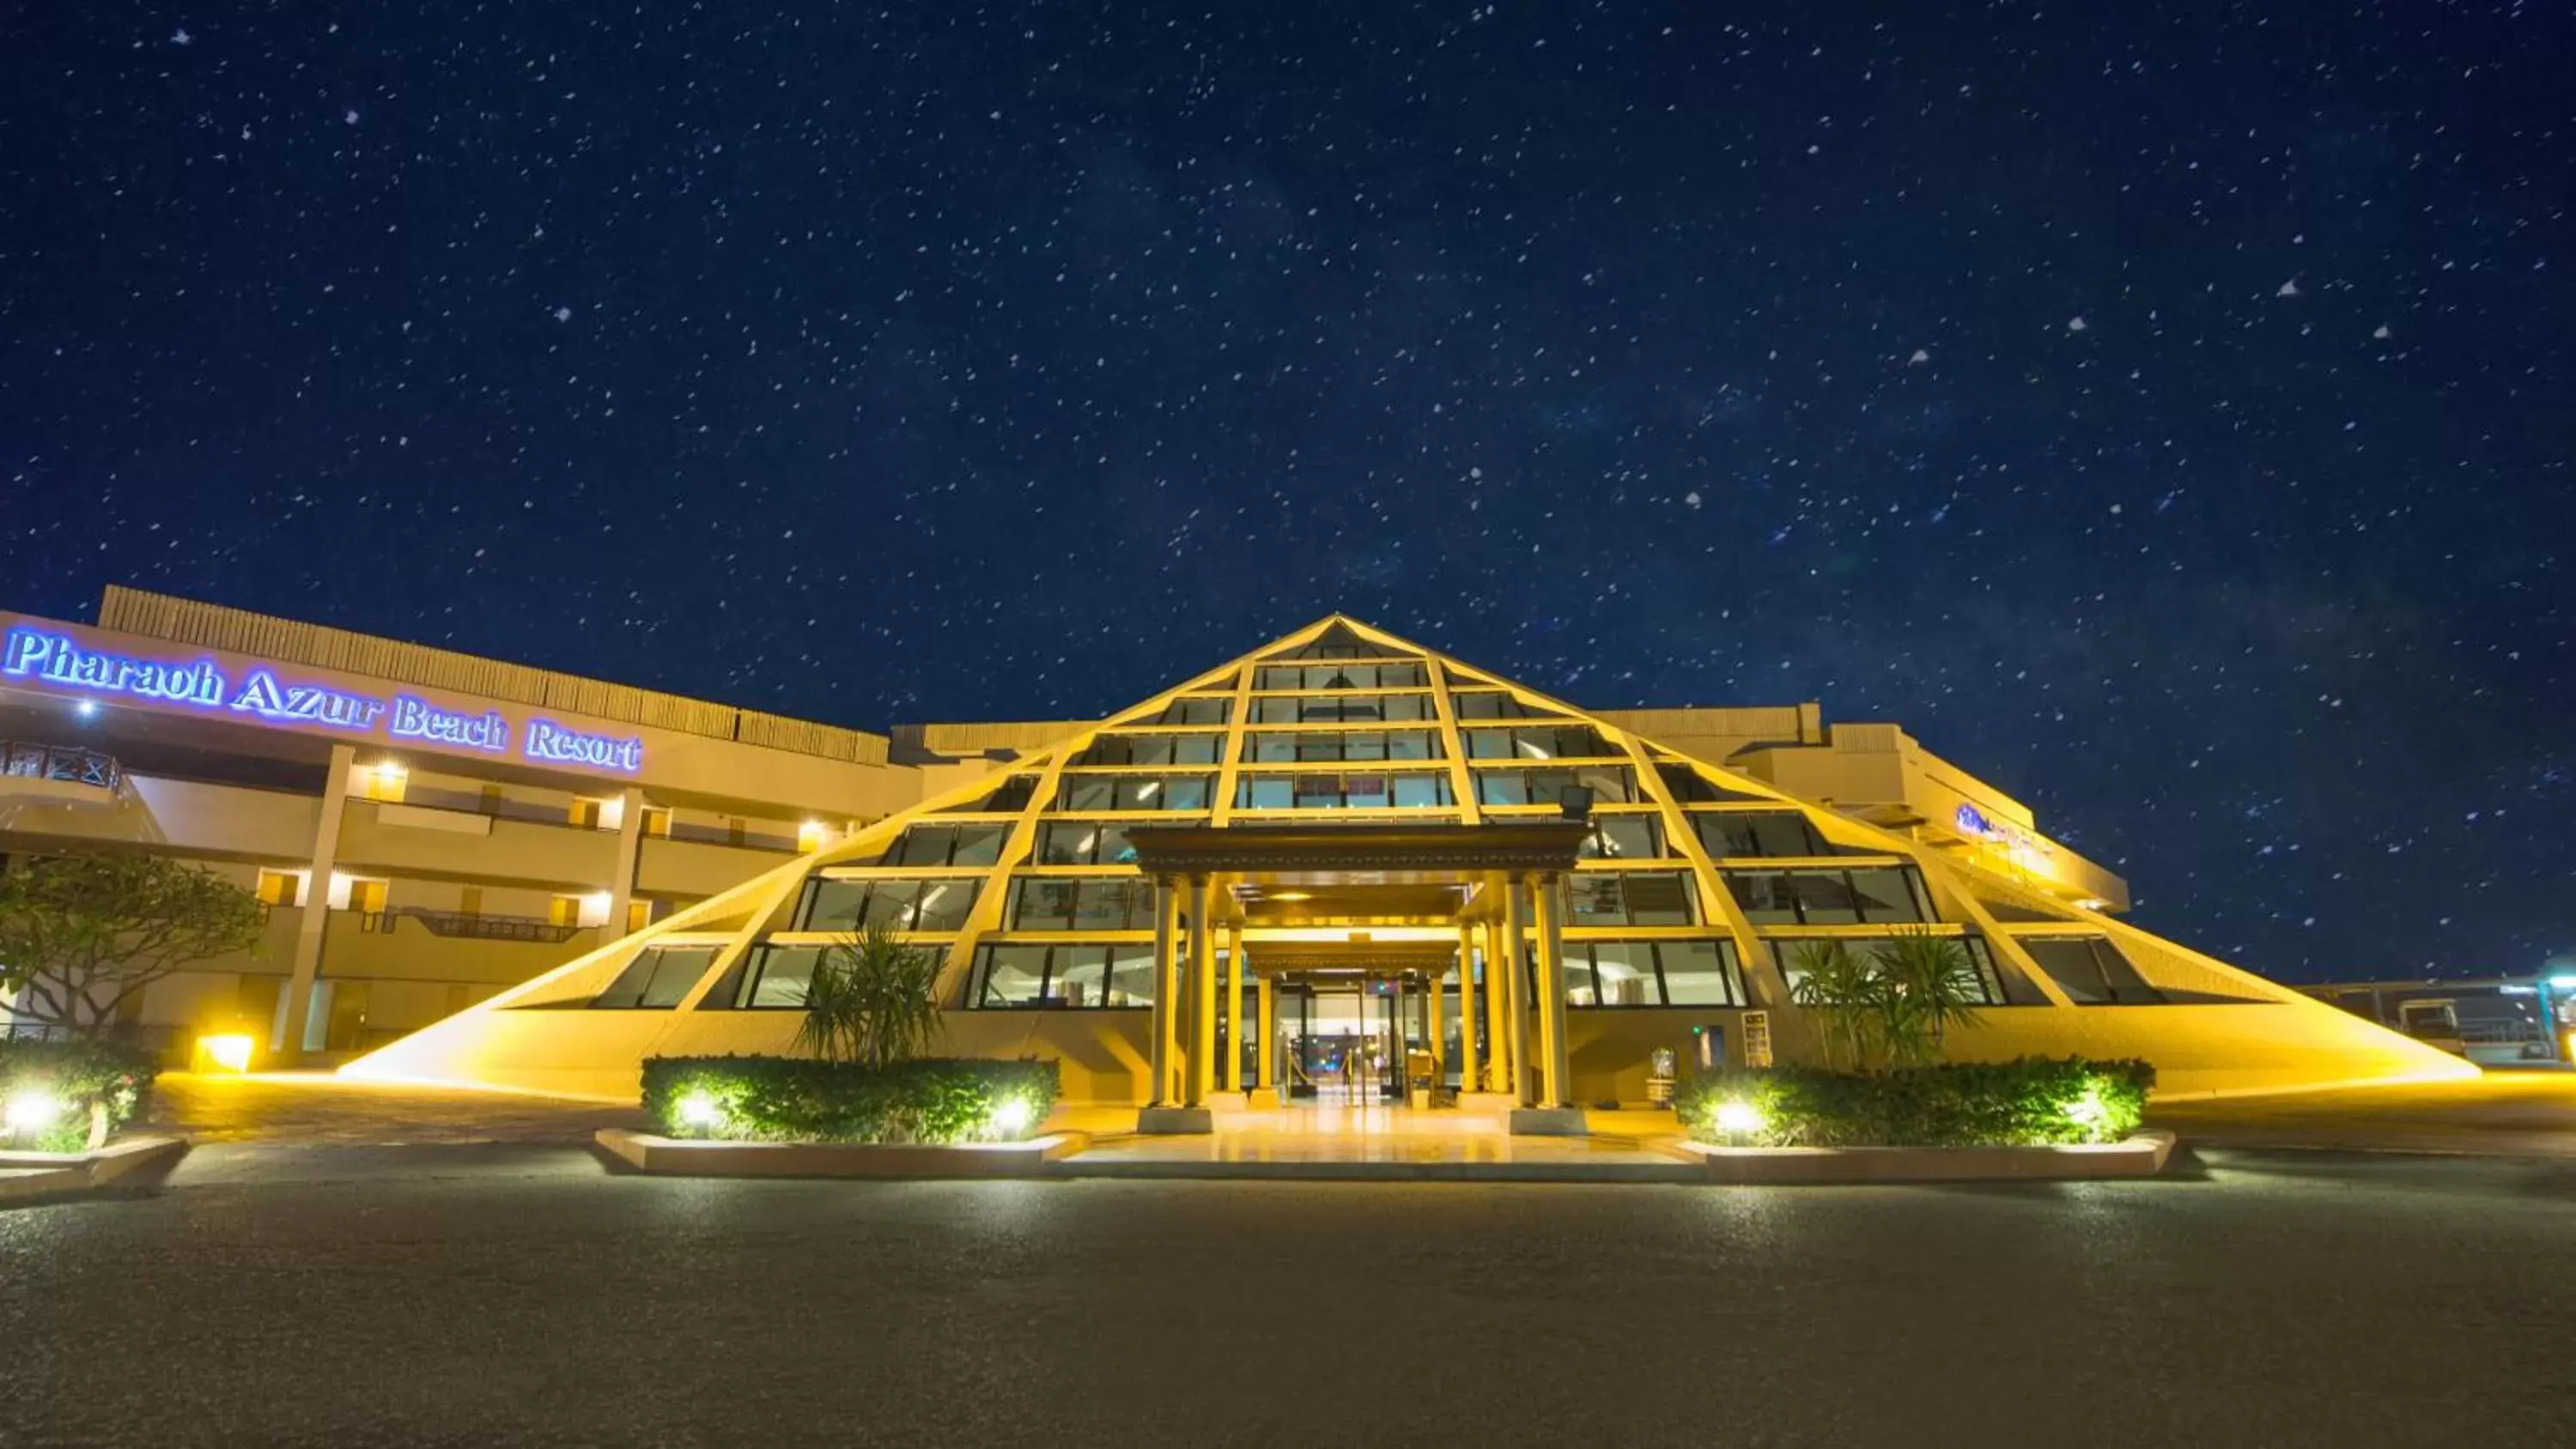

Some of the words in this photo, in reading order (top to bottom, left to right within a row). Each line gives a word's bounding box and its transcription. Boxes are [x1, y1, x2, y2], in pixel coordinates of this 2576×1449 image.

[3, 632, 223, 705] Pharaoh
[230, 672, 385, 728] Azur
[392, 698, 507, 749] Beach
[526, 723, 642, 770] Resort
